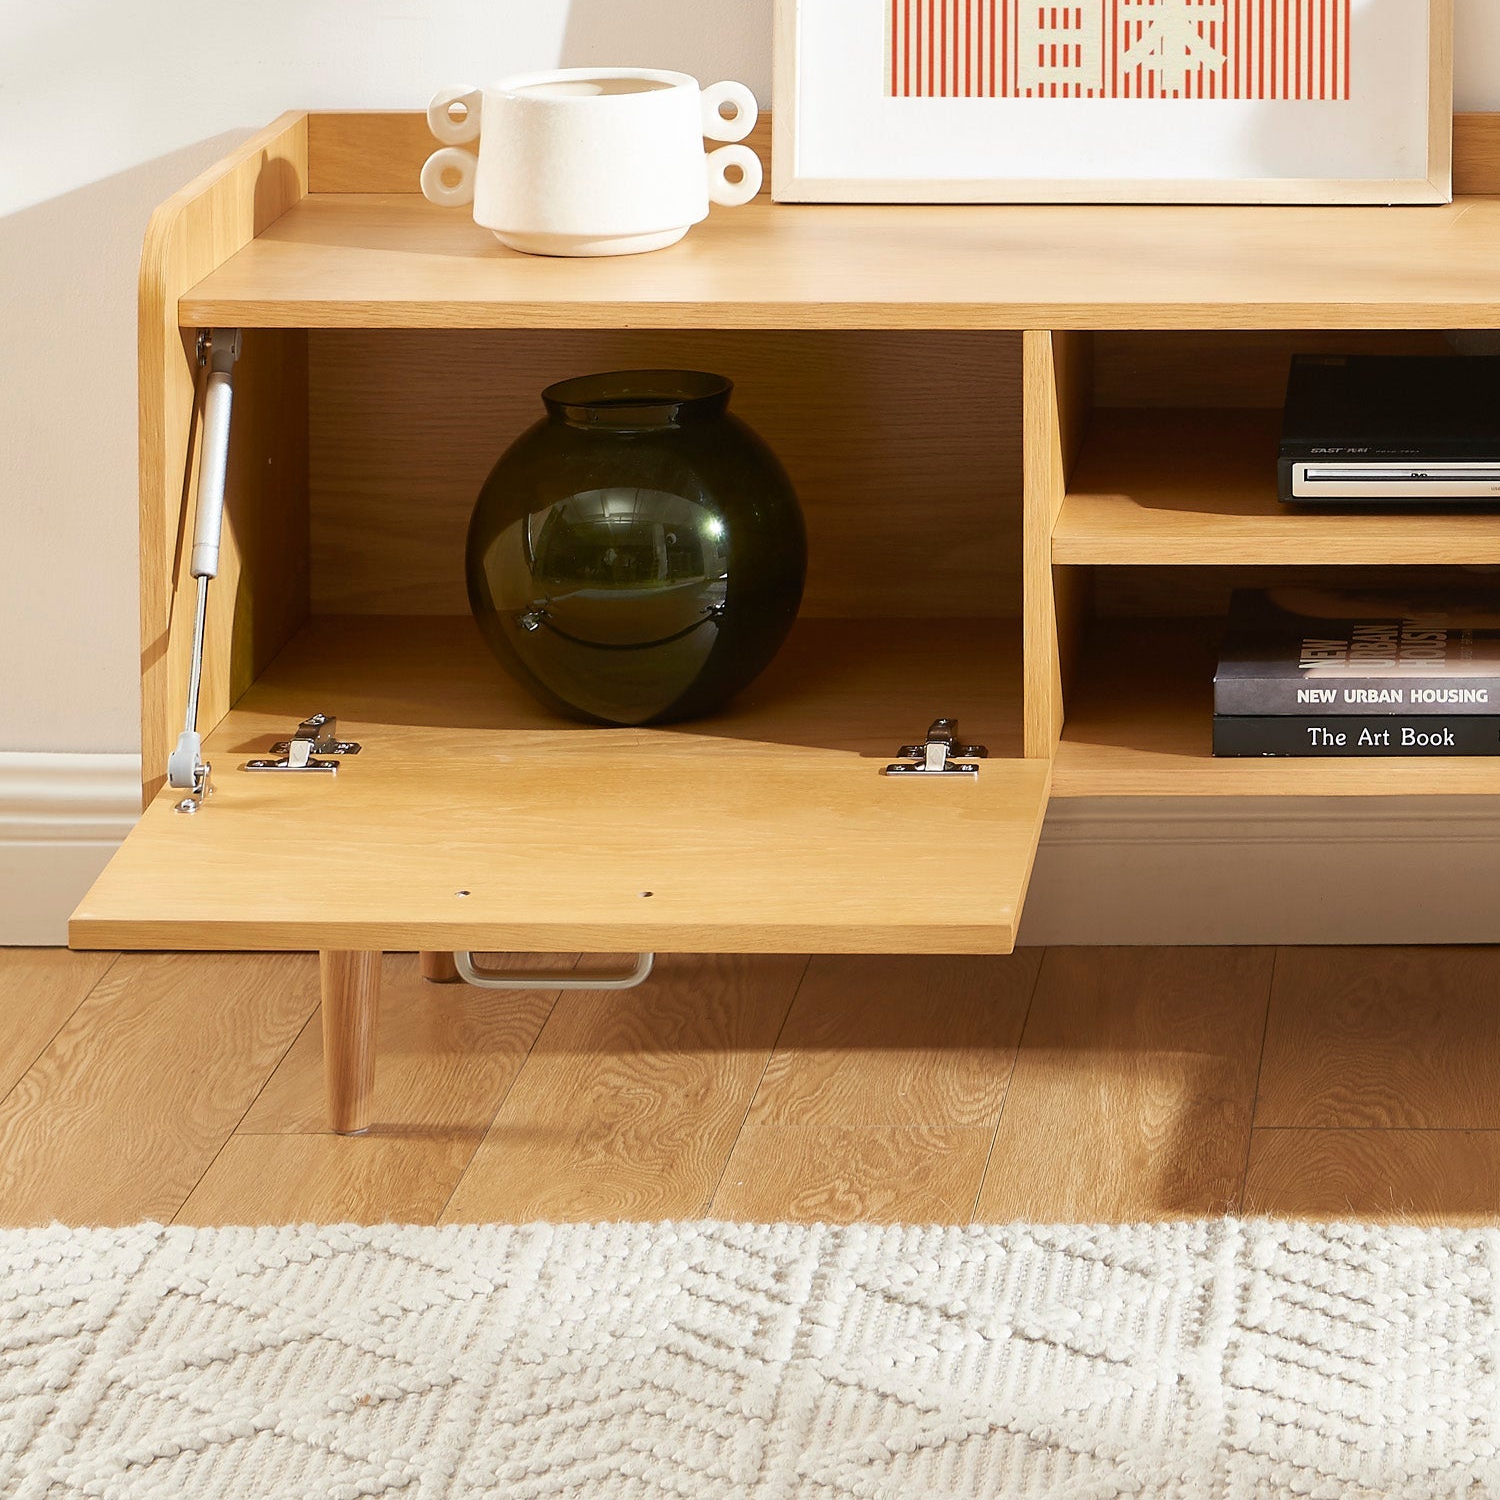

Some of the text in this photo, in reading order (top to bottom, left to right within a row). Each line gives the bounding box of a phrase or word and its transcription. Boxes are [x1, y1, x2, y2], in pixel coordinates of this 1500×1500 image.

[1298, 638, 1349, 669] NEW
[1347, 624, 1400, 669] URBAN
[1297, 689, 1337, 703] NEW
[1343, 689, 1403, 703] URBAN
[1410, 689, 1489, 703] HOUSING
[1307, 727, 1347, 746] The
[1357, 727, 1390, 746] Art
[1401, 727, 1455, 746] Book
